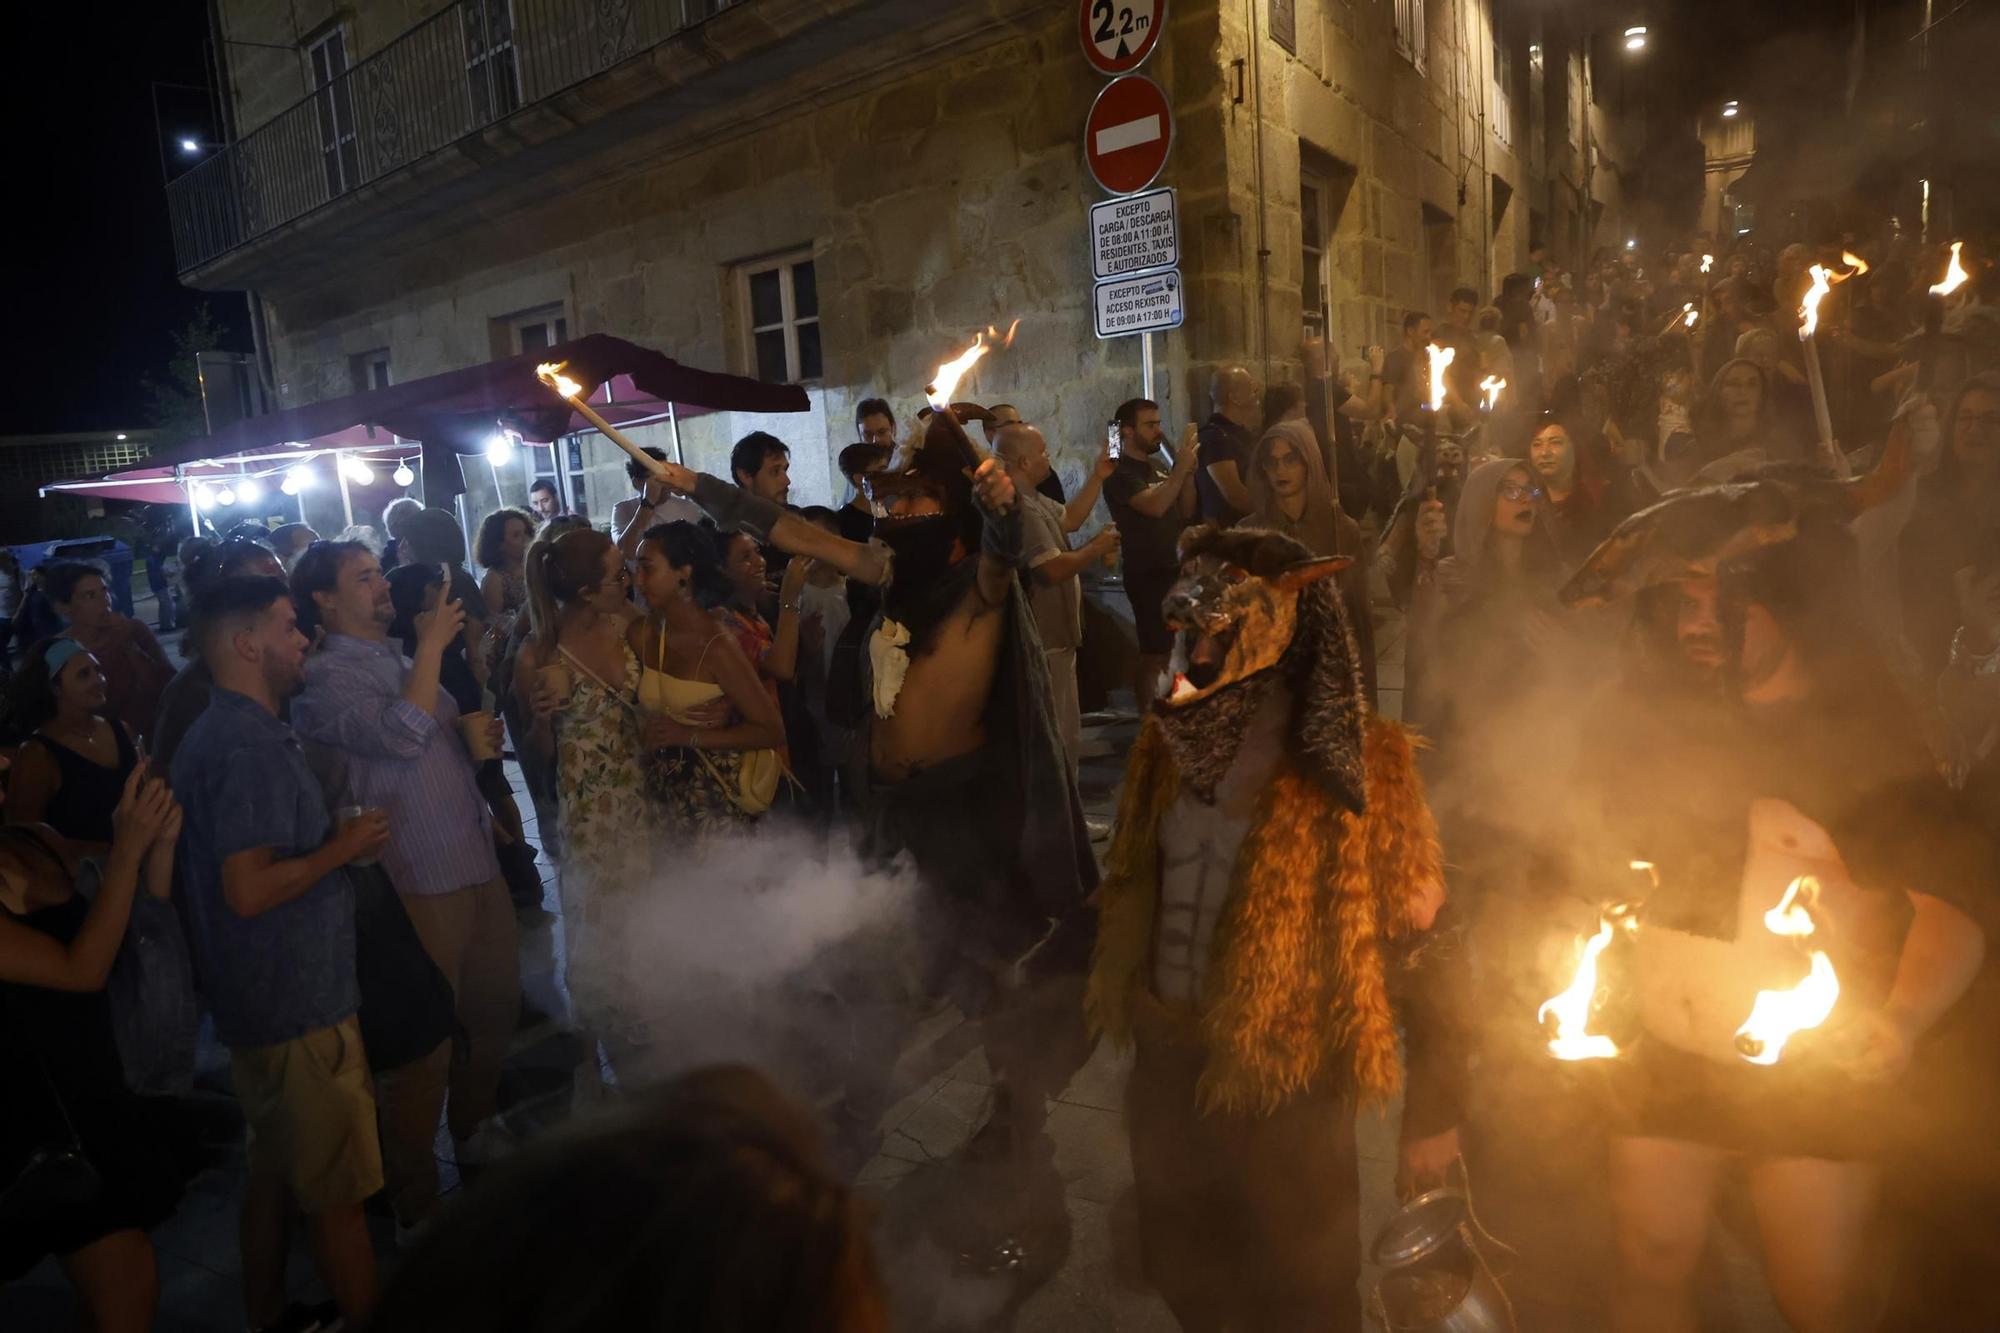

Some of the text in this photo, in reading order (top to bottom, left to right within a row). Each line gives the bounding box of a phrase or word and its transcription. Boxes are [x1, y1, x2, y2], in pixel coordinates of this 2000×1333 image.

[1116, 201, 1150, 218] EXCEPTO
[1100, 223, 1172, 248] DE 08:00 A 11:00 H.
[1152, 236, 1174, 251] TAXIS
[1107, 251, 1168, 273] E AUTORIZADOS
[1109, 286, 1140, 300] EXCEPTO
[1106, 294, 1170, 314] ACCESO REXISTRO
[1106, 317, 1116, 328] DE
[1116, 314, 1136, 326] 09:00
[1136, 314, 1142, 323] A
[1142, 310, 1163, 322] 17:00
